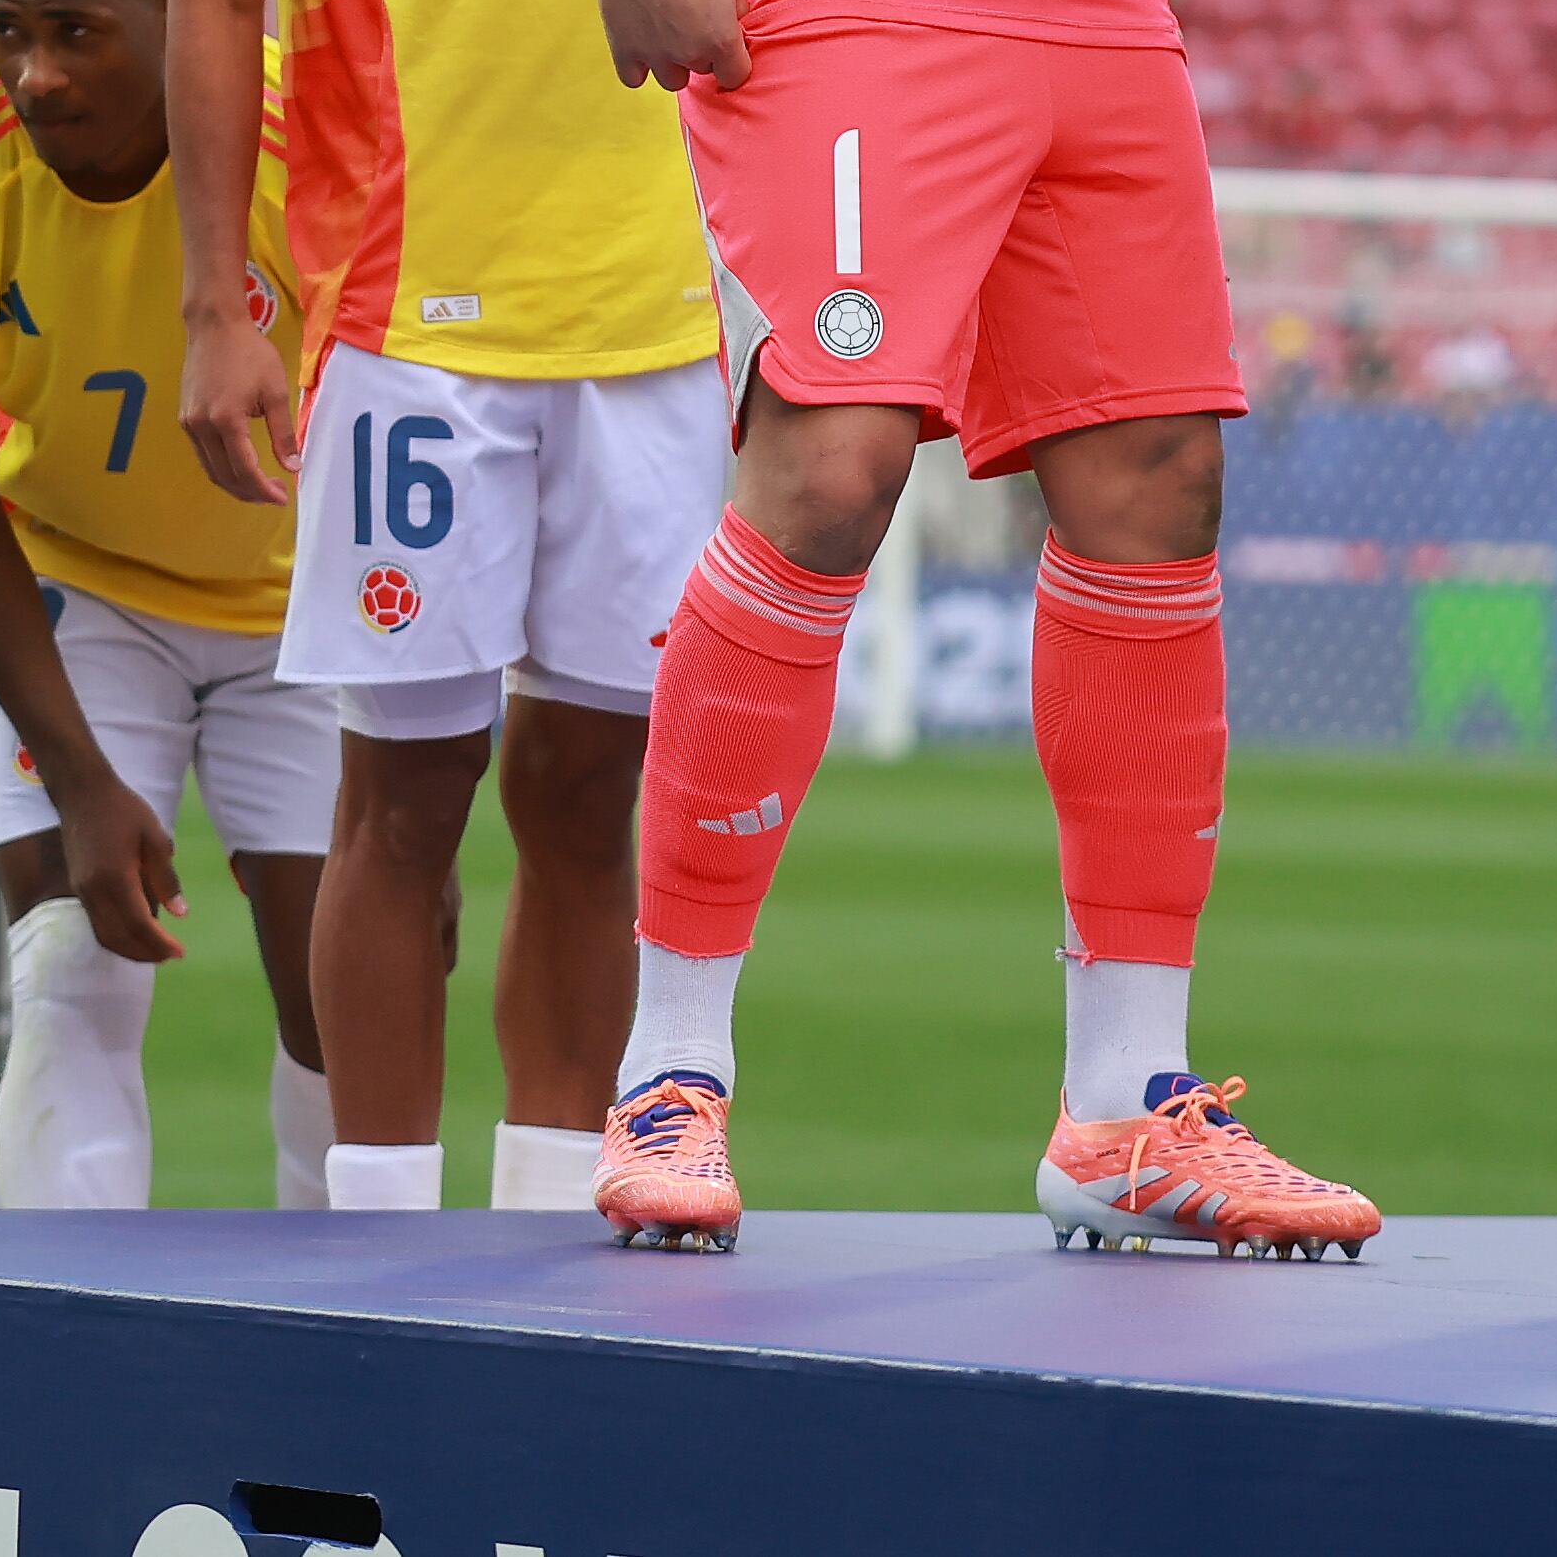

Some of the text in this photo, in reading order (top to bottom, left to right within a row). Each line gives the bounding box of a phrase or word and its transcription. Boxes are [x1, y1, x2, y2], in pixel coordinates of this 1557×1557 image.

[833, 128, 862, 274] 1
[83, 369, 147, 473] 7
[354, 411, 455, 550] 16
